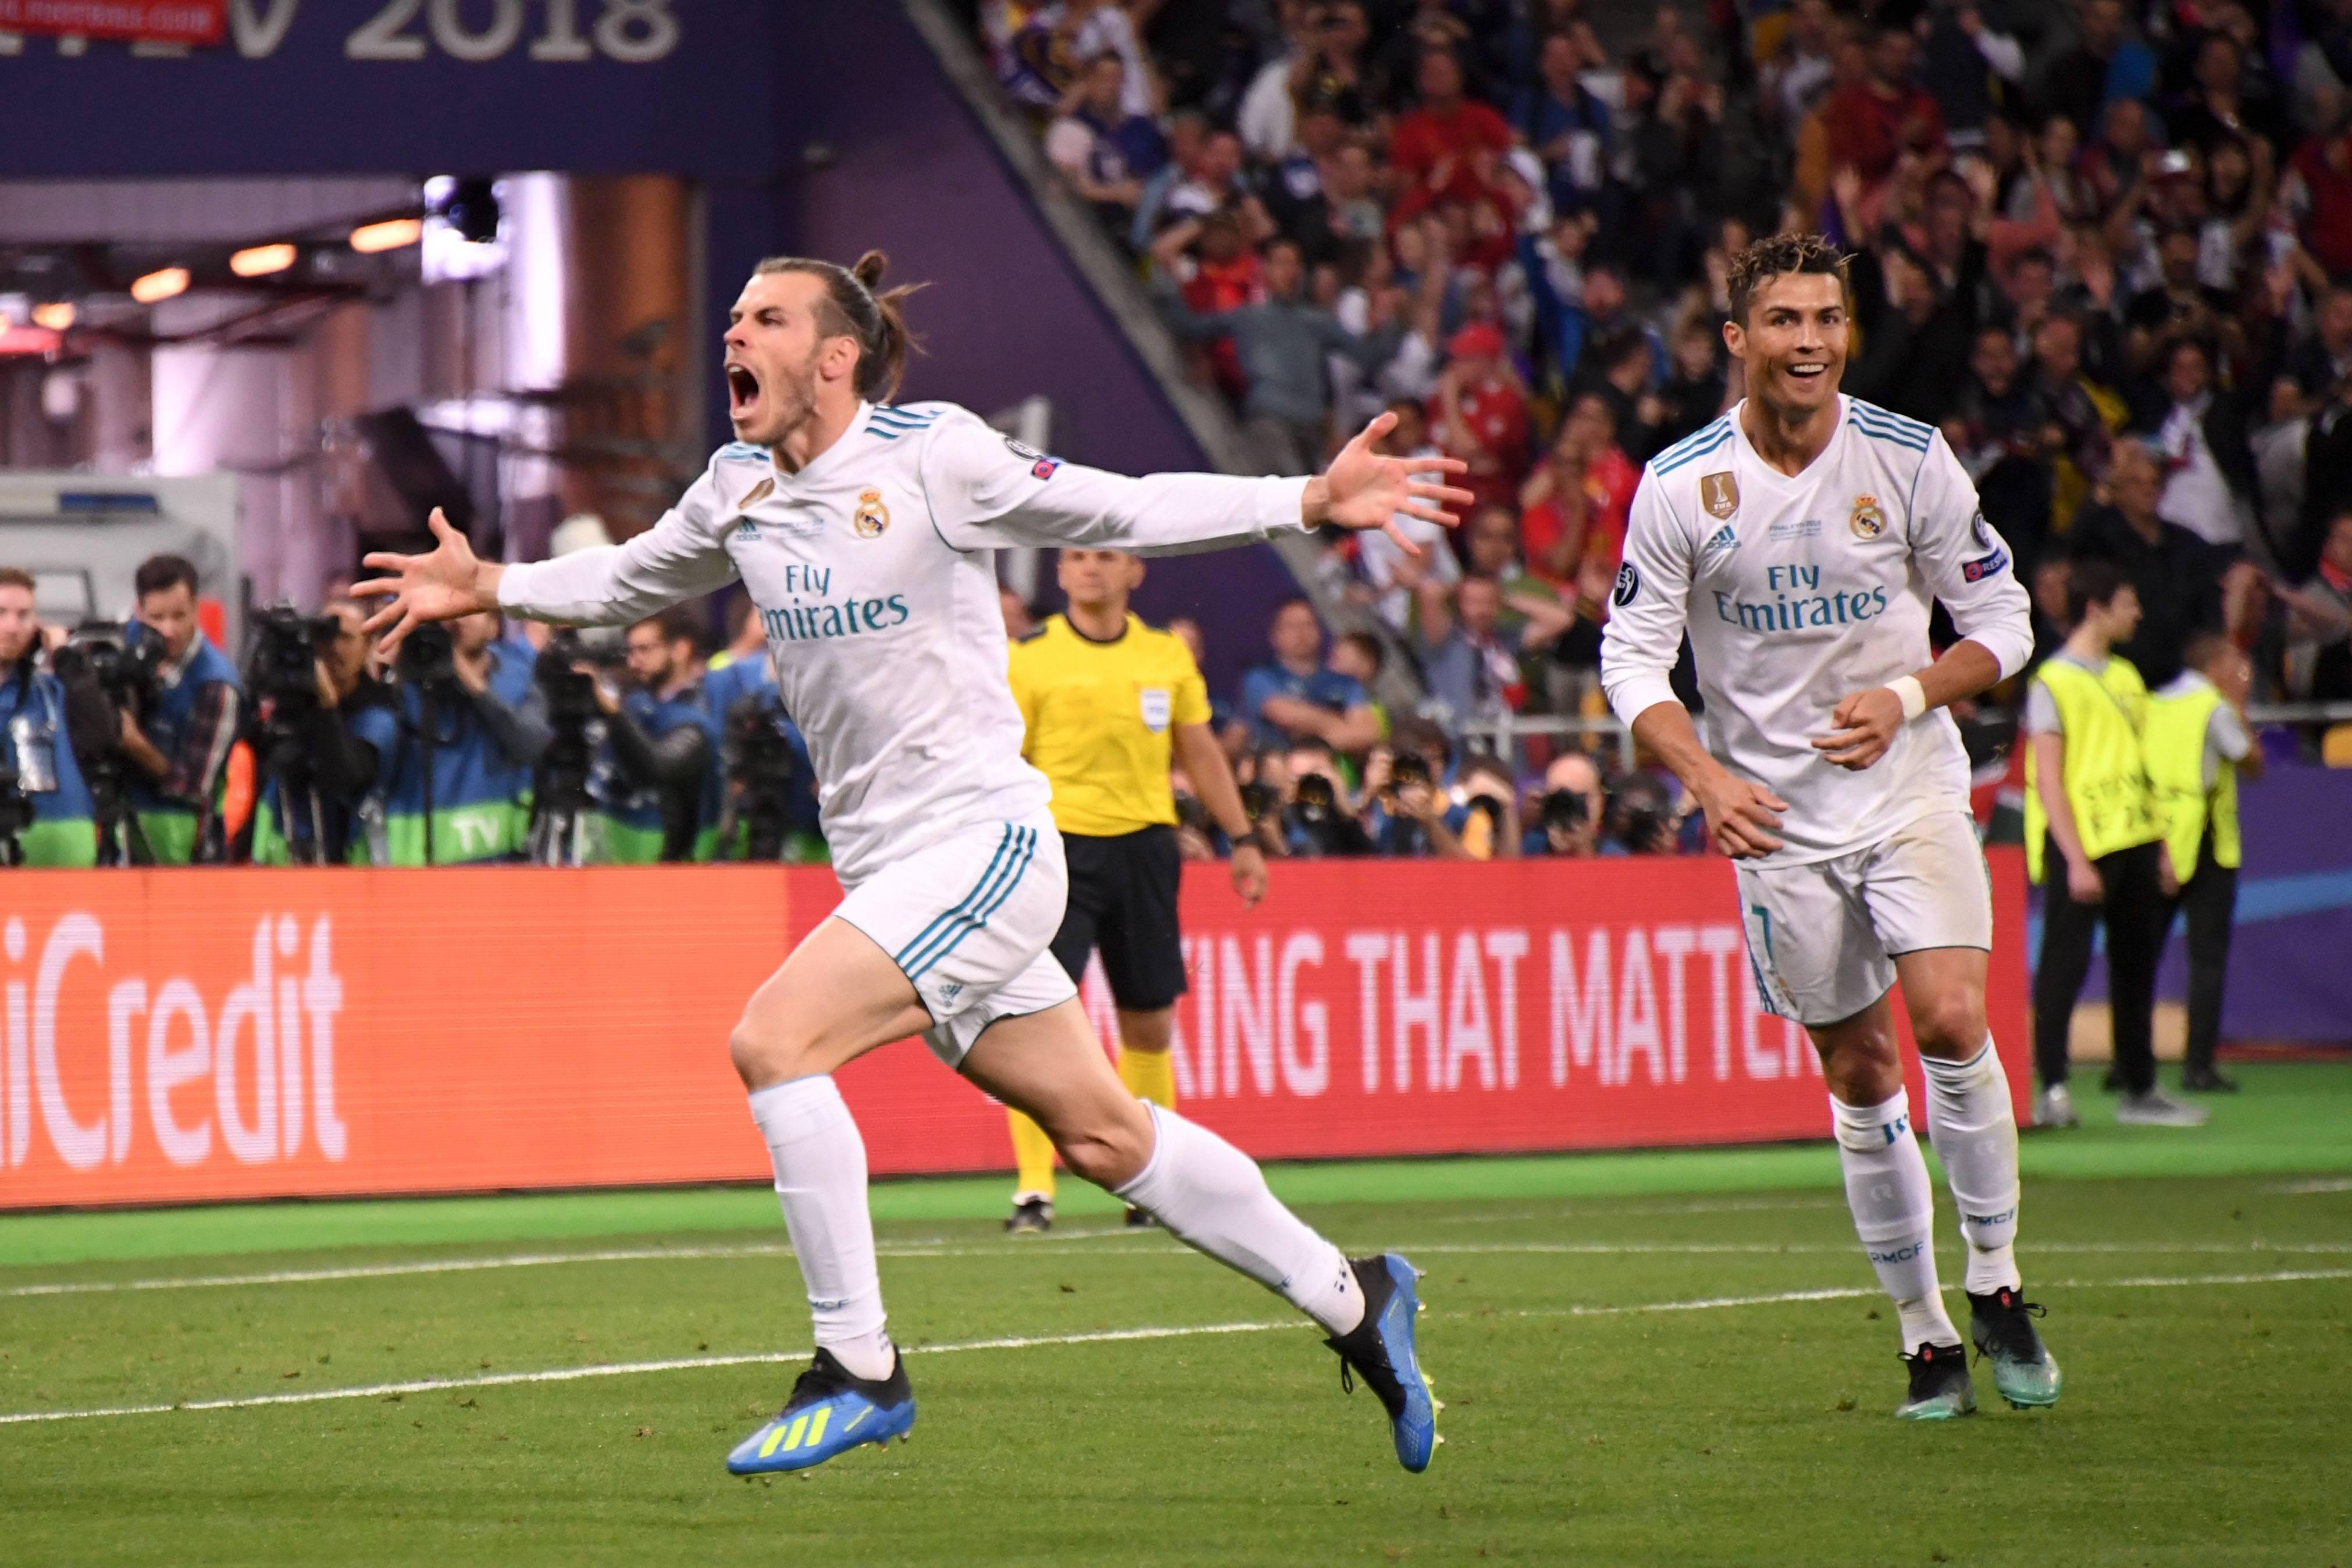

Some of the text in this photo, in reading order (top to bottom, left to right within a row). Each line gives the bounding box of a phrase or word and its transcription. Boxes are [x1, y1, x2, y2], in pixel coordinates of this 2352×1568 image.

[344, 0, 679, 62] 2018
[785, 564, 831, 597] Fly
[1766, 564, 1819, 590] Fly
[761, 594, 908, 640] mirates
[1712, 585, 1887, 631] Emirates
[450, 815, 499, 853] TV
[1751, 903, 1774, 960] 7
[1345, 927, 1529, 1093] THAT
[0, 911, 347, 1171] iCredit
